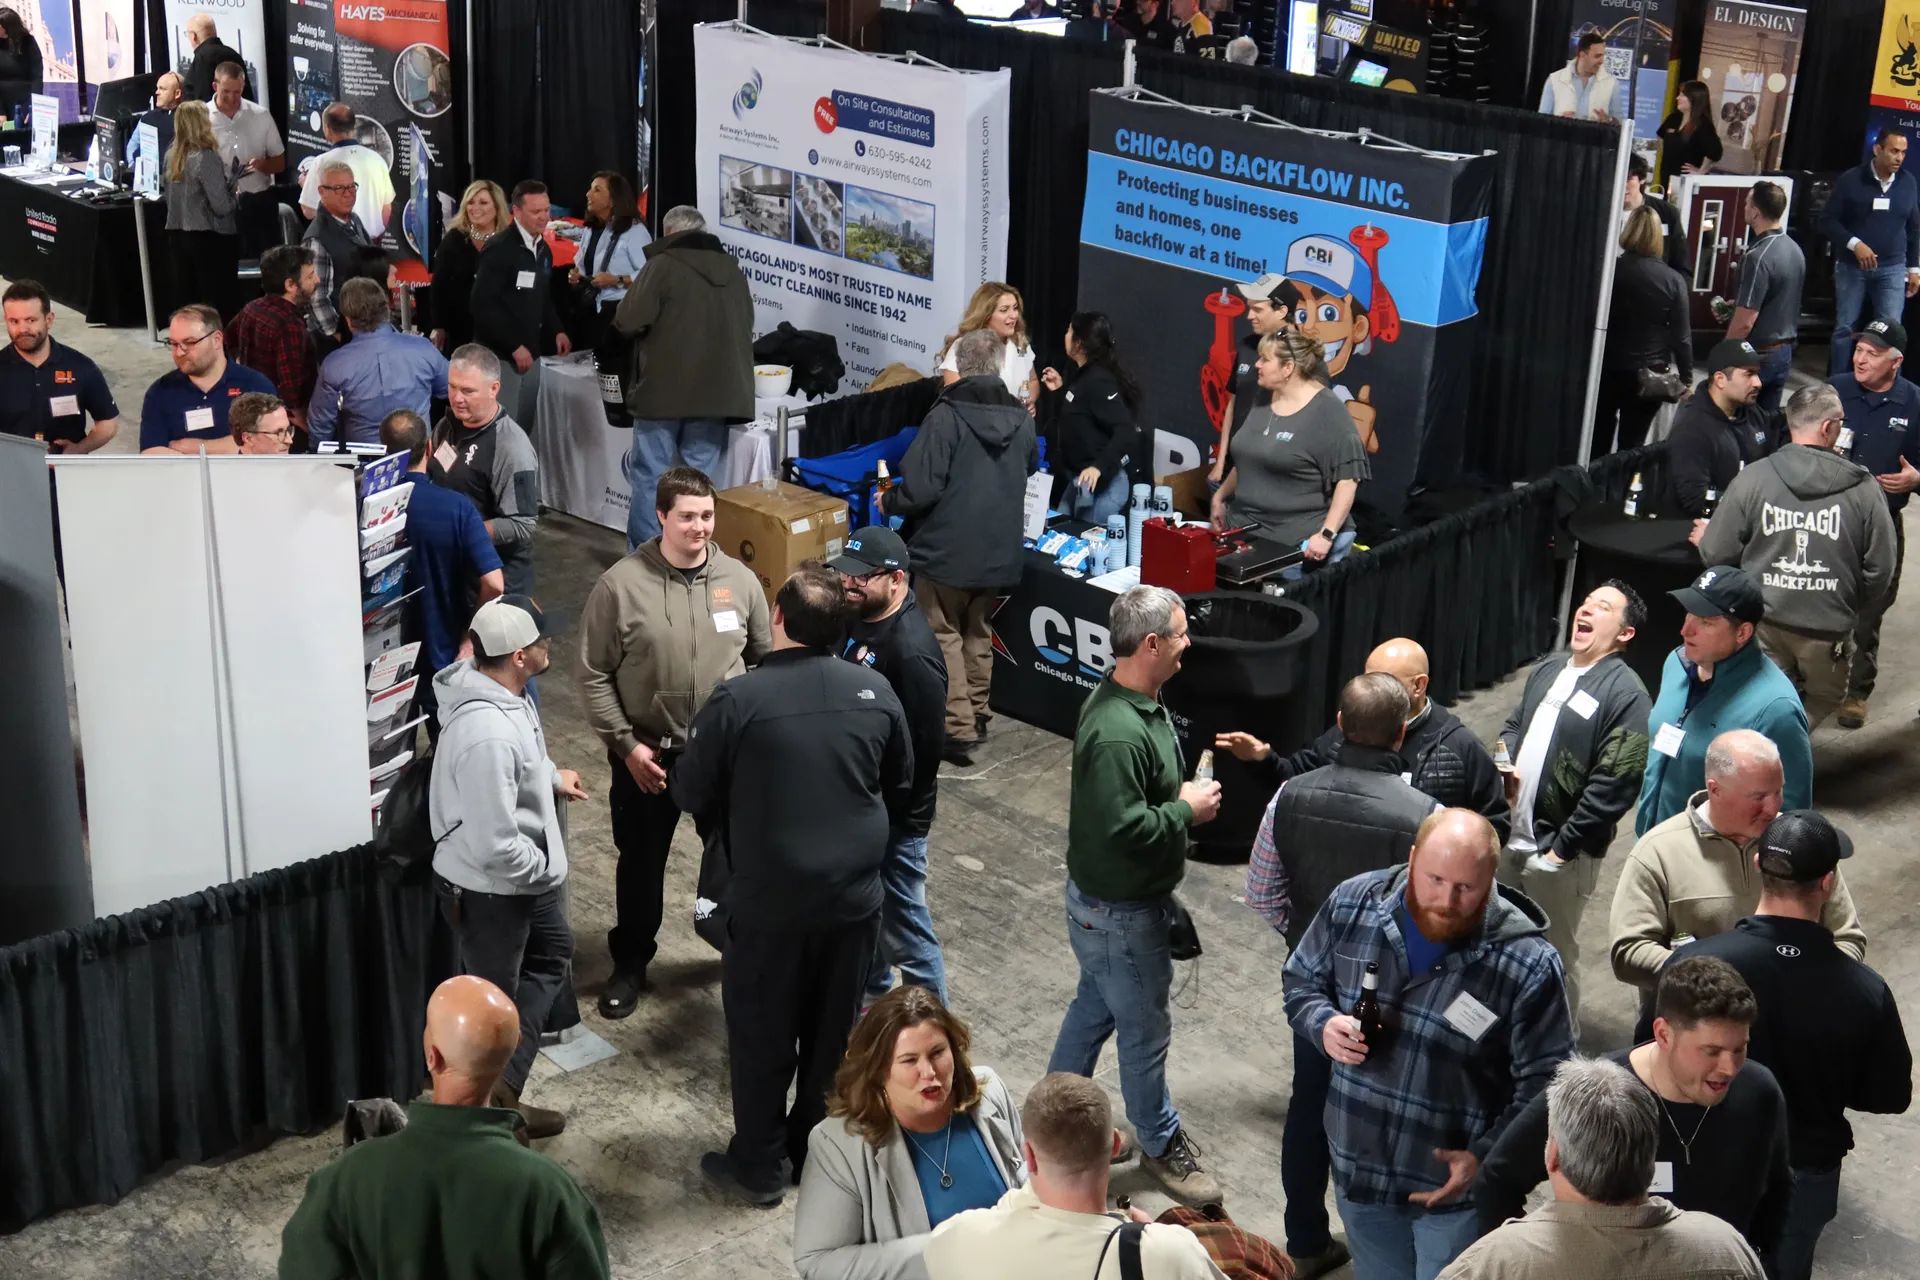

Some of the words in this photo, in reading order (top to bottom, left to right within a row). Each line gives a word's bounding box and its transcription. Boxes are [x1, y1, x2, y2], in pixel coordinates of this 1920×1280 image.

[340, 4, 386, 21] HAYES
[386, 10, 439, 19] MECHANICAL
[1600, 0, 1659, 11] EverLigts
[1714, 6, 1732, 22] EL
[1739, 10, 1795, 32] DESIGN
[297, 22, 317, 38] Solving
[290, 34, 304, 45] safer
[305, 38, 333, 52] everywhere
[1375, 31, 1421, 53] UNITED
[1200, 47, 1215, 60] 23
[817, 106, 835, 126] FREE
[837, 94, 850, 106] On
[852, 97, 869, 110] Site
[871, 101, 930, 124] Consultations
[720, 124, 743, 136] Airways
[744, 129, 768, 141] Systems
[768, 134, 780, 143] Inc.
[868, 118, 885, 130] and
[887, 121, 930, 140] Estimates
[868, 145, 932, 170] 630-595-4242
[821, 155, 932, 188] www.airwayssystems.com
[1115, 129, 1214, 169] CHICAGO
[1220, 150, 1353, 197] BACKFLOW
[1359, 177, 1410, 209] INC.
[1117, 169, 1199, 206] Protecting
[1204, 189, 1298, 224] businesses
[26, 207, 41, 220] United
[42, 212, 56, 225] Radio
[1116, 200, 1144, 218] and
[1149, 204, 1205, 235] homes,
[1211, 222, 1241, 240] one
[1115, 225, 1185, 254] backflow
[1189, 242, 1206, 260] at
[1210, 249, 1219, 263] a
[1224, 252, 1267, 275] time!
[1305, 246, 1333, 263] CBI
[721, 243, 806, 275] CHICAGOLAND'S
[809, 266, 839, 285] MOST
[842, 275, 894, 299] TRUSTED
[897, 290, 932, 310] NAME
[741, 266, 752, 279] IN
[755, 269, 783, 288] DUCT
[786, 279, 841, 304] CLEANING
[844, 295, 877, 315] SINCE
[880, 305, 906, 323] 1942
[753, 294, 783, 310] Systems
[1870, 321, 1889, 333] CBI
[851, 342, 870, 354] Fans
[852, 323, 888, 341] Industrial
[891, 334, 926, 353] Cleaning
[851, 361, 879, 377] Laundr
[1889, 417, 1908, 427] CBI
[1276, 431, 1294, 442] CBI
[1762, 502, 1840, 540] CHICAGO
[1762, 573, 1839, 591] BACKFLOW
[713, 588, 730, 599] VANS
[1030, 606, 1116, 674] CB
[1035, 661, 1073, 682] Chicago
